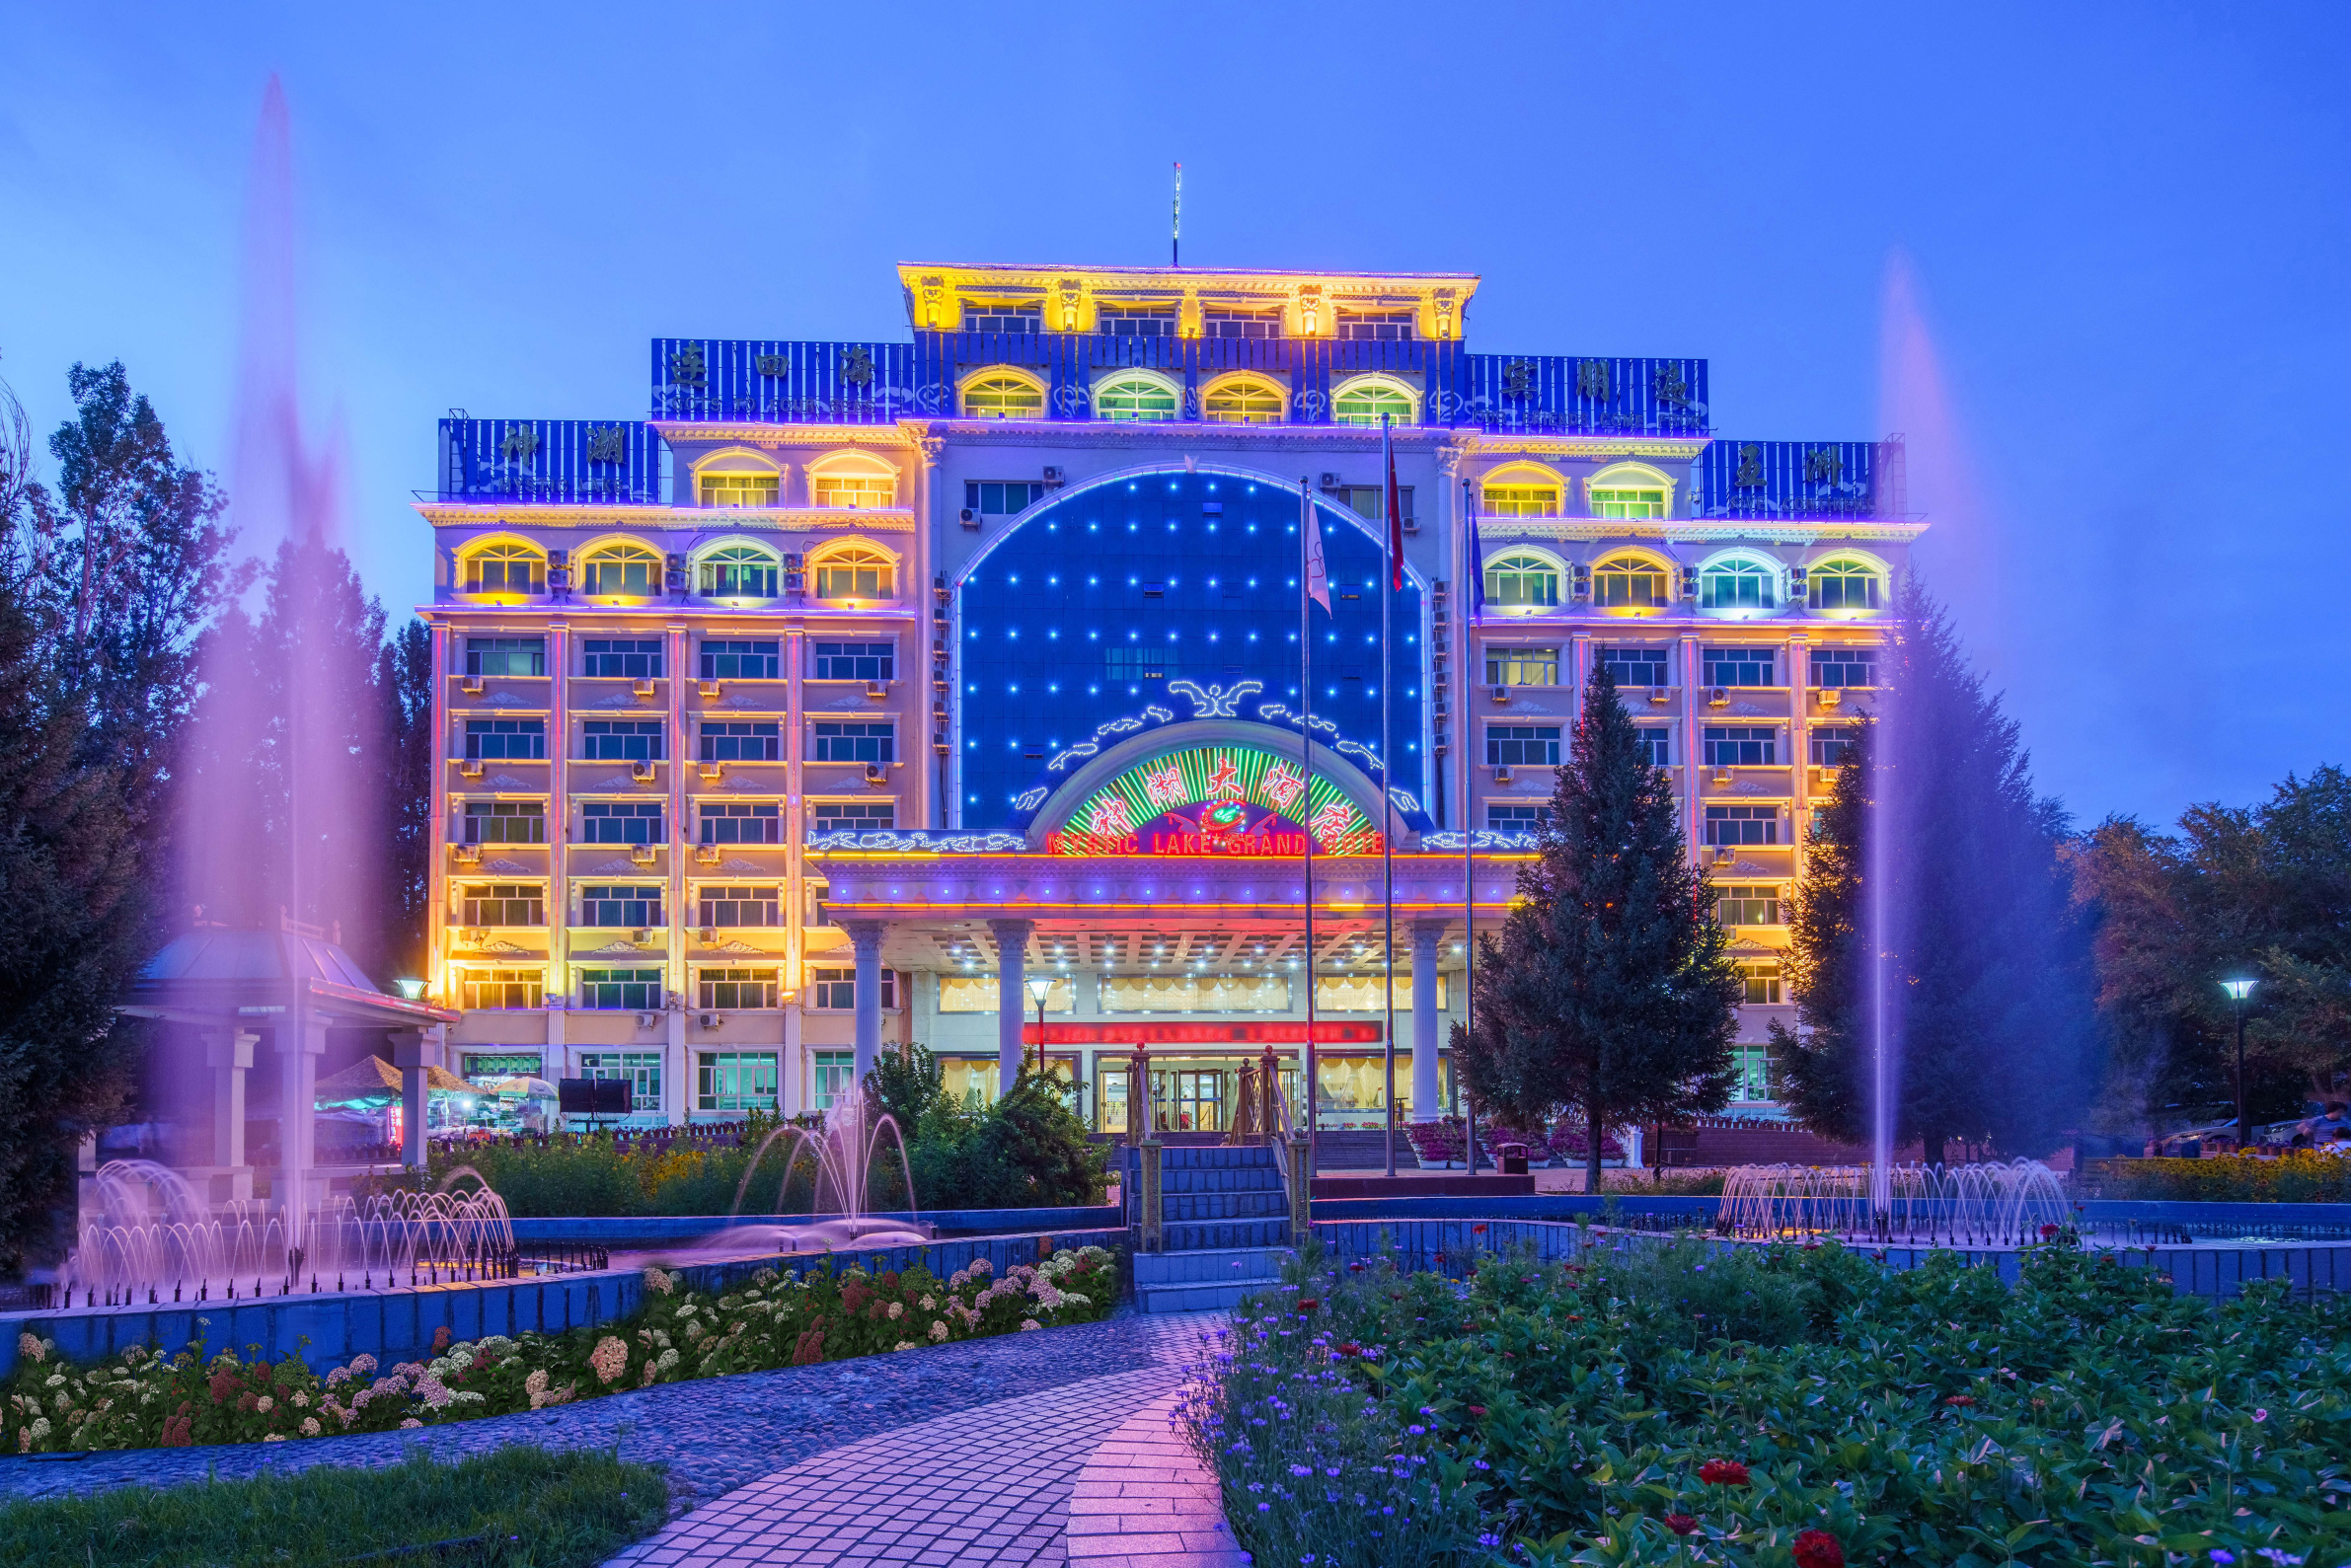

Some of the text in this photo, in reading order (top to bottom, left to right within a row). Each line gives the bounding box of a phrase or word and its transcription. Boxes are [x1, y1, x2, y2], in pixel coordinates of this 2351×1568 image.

[498, 424, 625, 467] 神湖
[497, 478, 624, 493] MYSTIC LAKE
[1092, 758, 1351, 840] 神湖大酒店
[1047, 833, 1138, 855] MYSTIC
[1154, 834, 1212, 855] LAKE
[1227, 834, 1306, 856] GRAND
